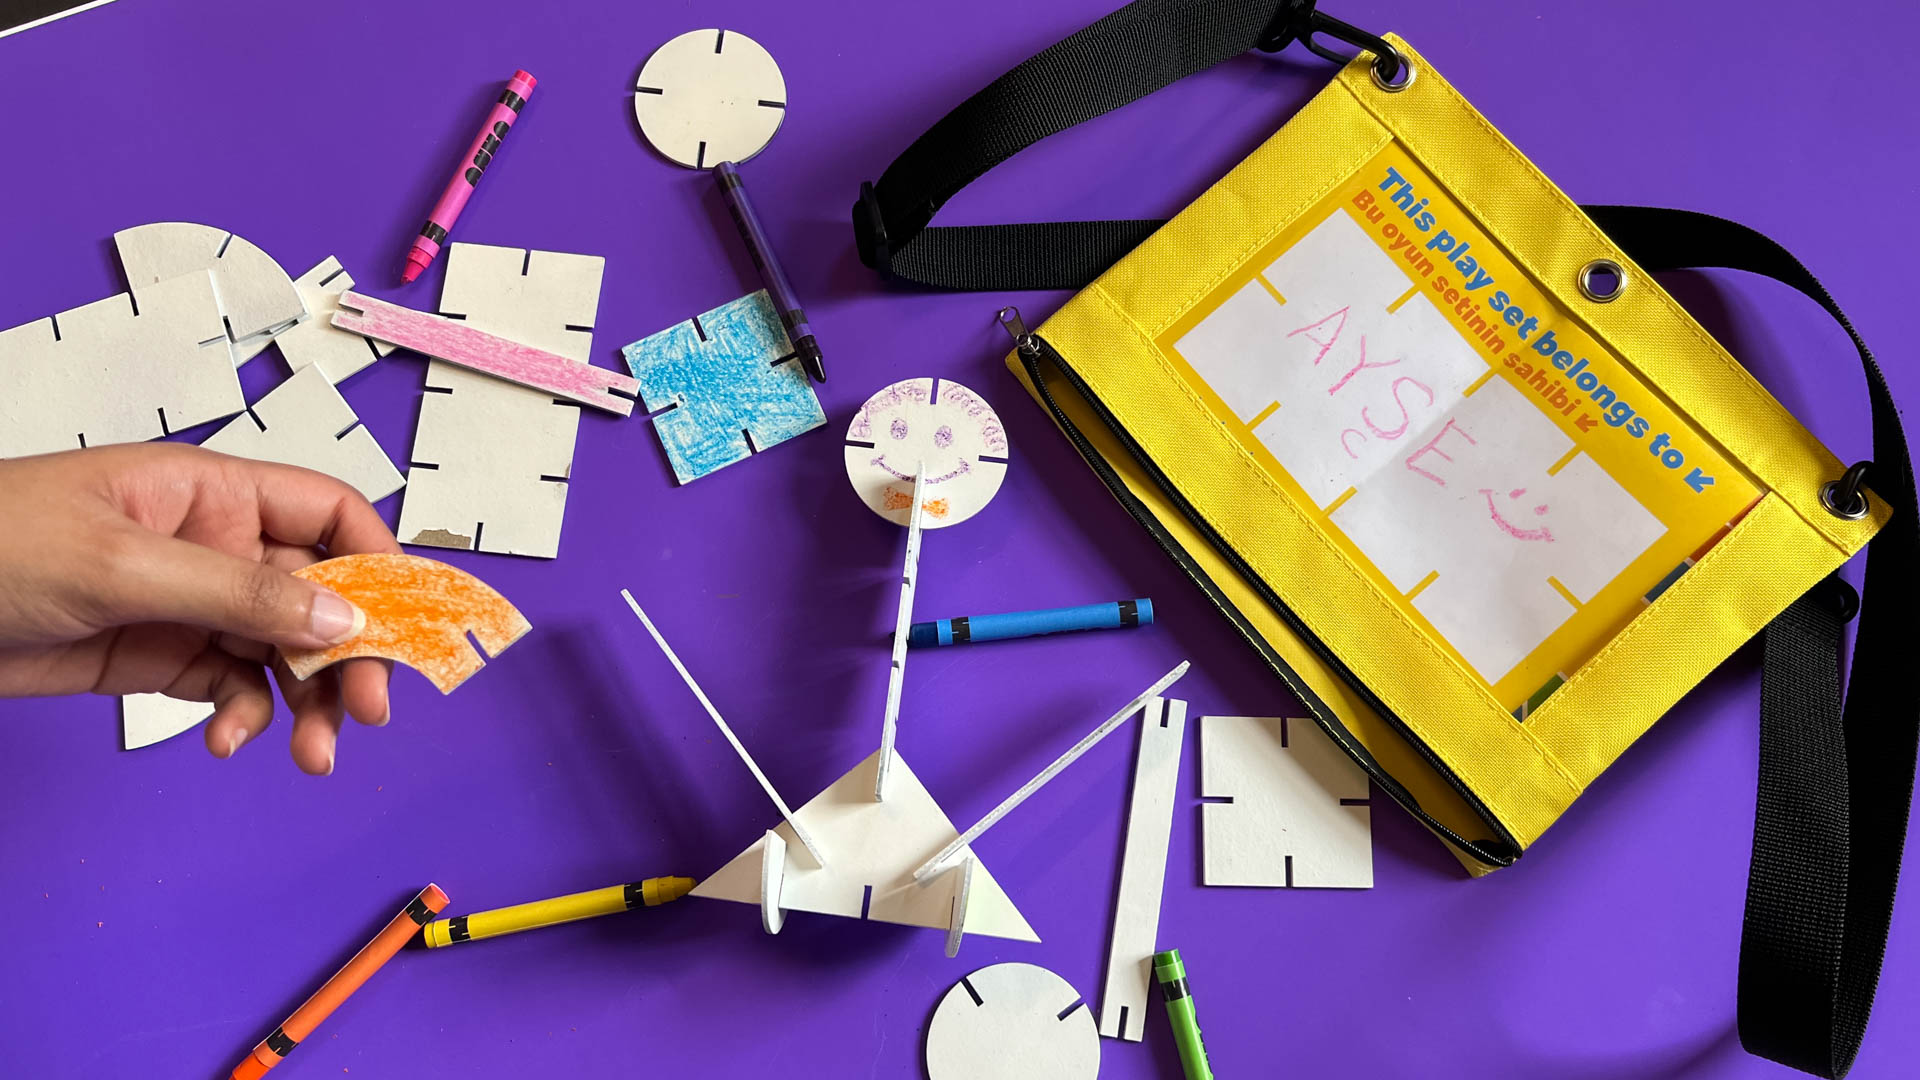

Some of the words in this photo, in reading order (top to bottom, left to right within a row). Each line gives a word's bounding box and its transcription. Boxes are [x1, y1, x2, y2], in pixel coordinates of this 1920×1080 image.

[1352, 189, 1385, 225] Bu
[1381, 221, 1435, 278] oyun
[1431, 275, 1505, 355] setinin
[1503, 351, 1583, 417] sahibi
[1378, 166, 1436, 232] This
[1426, 229, 1494, 291] play
[1488, 290, 1539, 340] set
[1533, 330, 1650, 438] belongs
[1648, 432, 1684, 469] to
